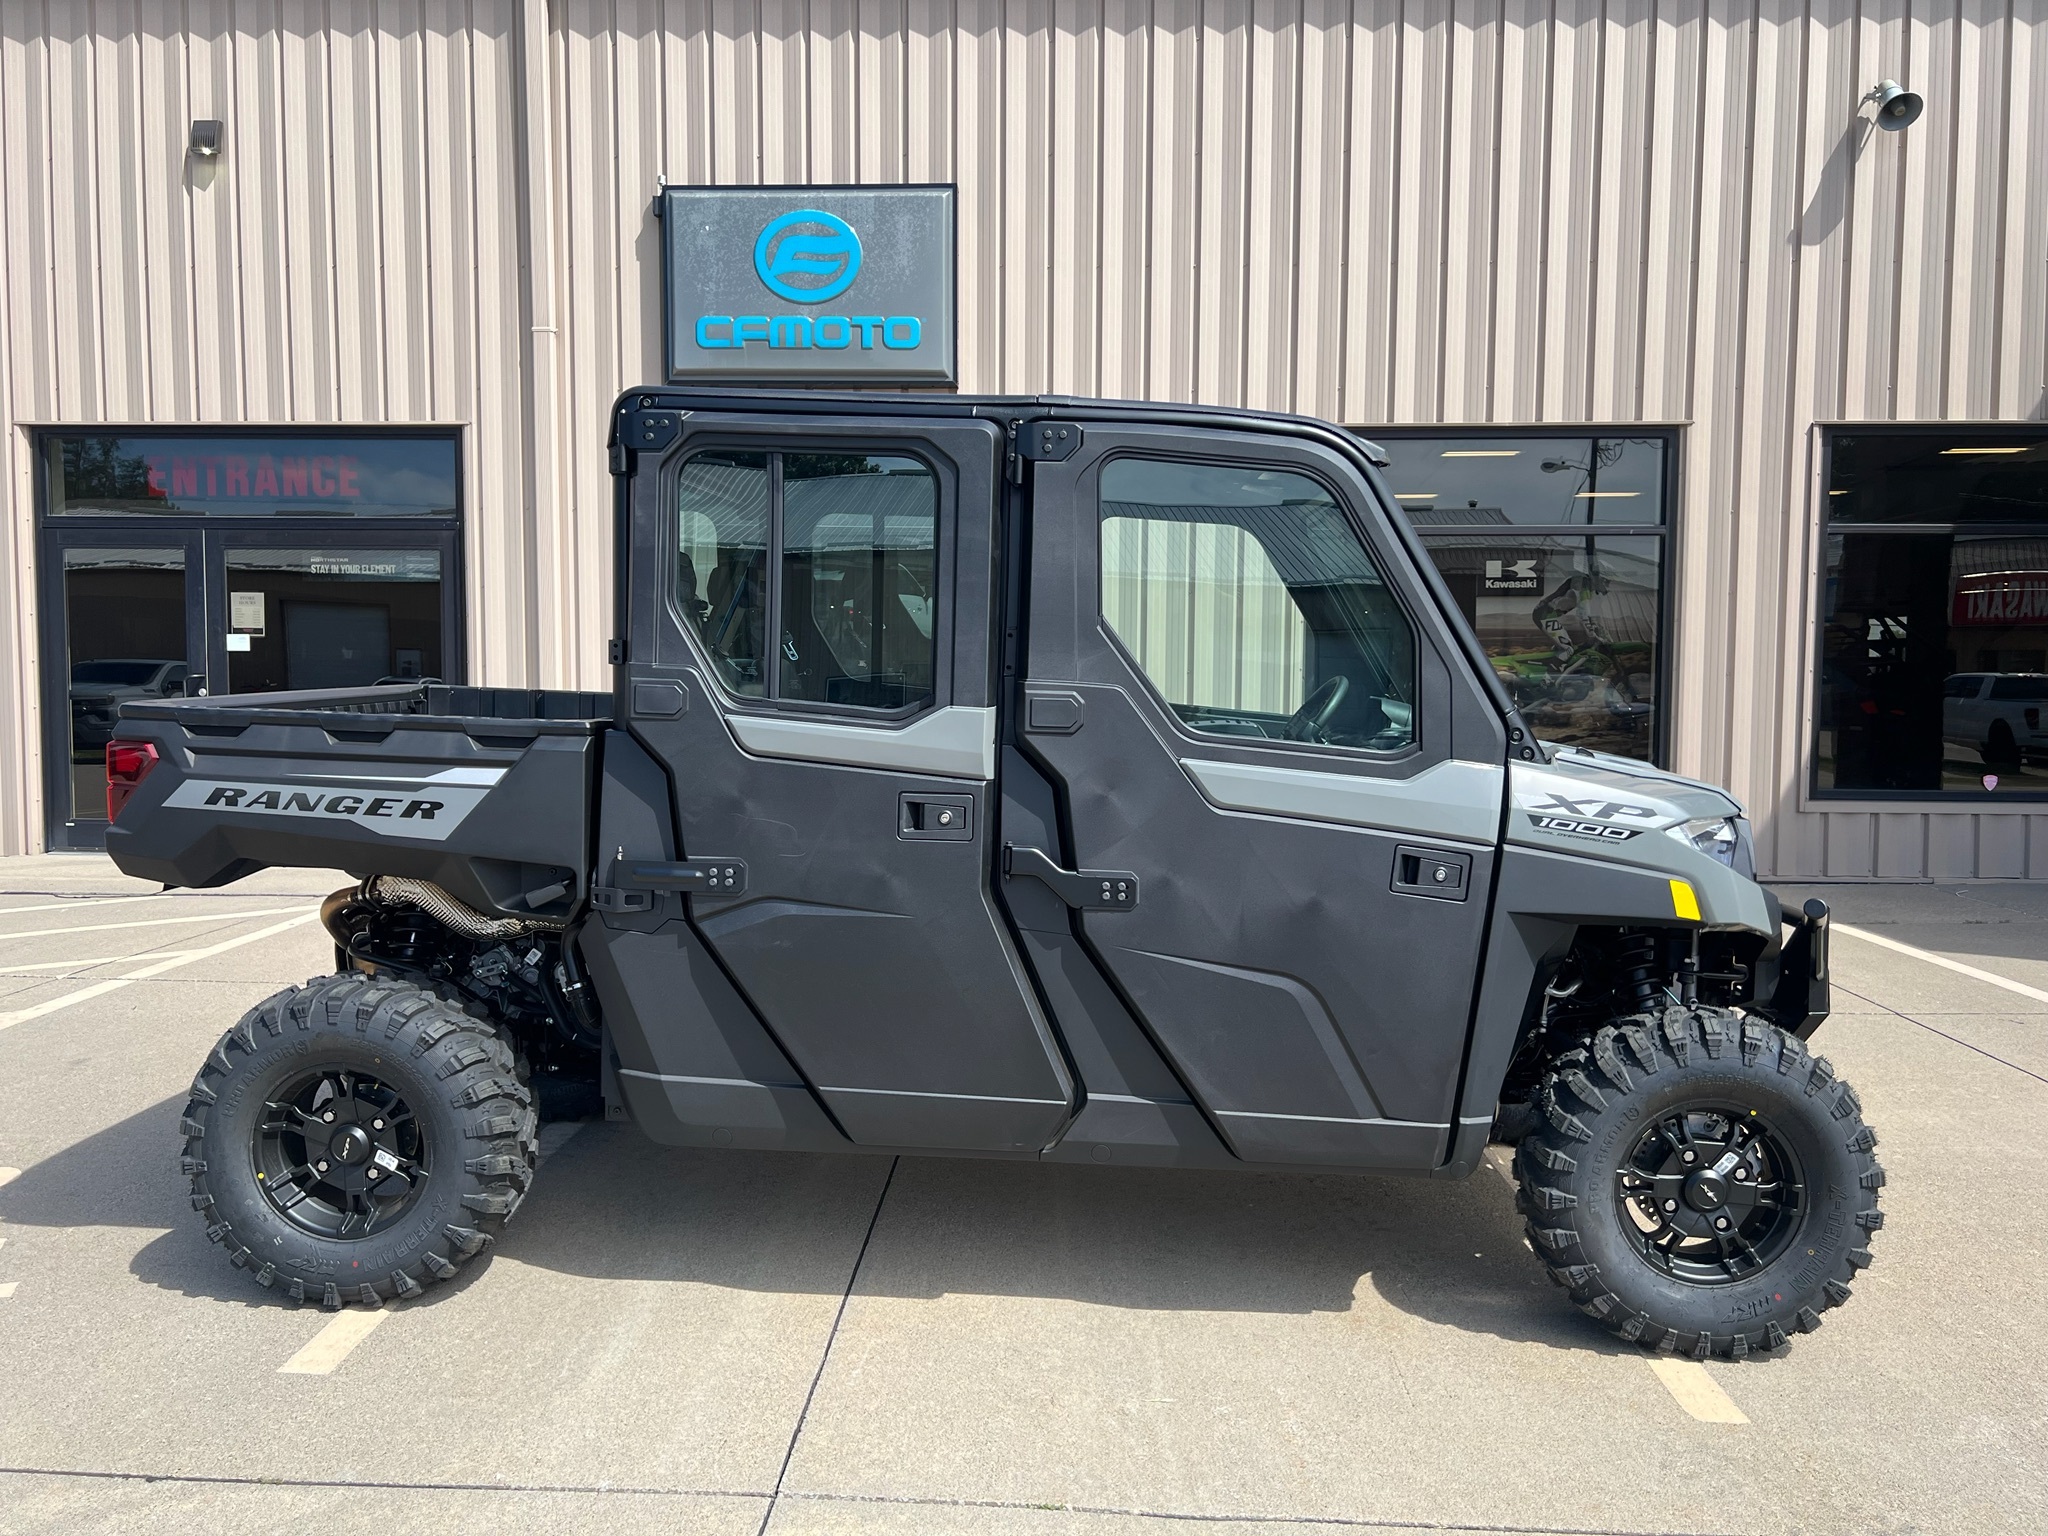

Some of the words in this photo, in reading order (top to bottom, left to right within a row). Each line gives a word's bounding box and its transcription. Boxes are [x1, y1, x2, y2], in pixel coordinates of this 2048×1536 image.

[695, 315, 922, 350] CFMOTO
[148, 455, 361, 498] ENTRANCE
[310, 564, 330, 574] STAY
[331, 564, 340, 574] IN
[341, 564, 361, 574] YOUR
[362, 564, 397, 575] ELEMENT
[1485, 579, 1537, 589] Kawasaki
[203, 787, 445, 820] RANGER
[1528, 792, 1658, 820] XP
[1532, 828, 1555, 837] DUAL
[1556, 831, 1601, 843] OVERHEAD
[1538, 817, 1631, 839] 1000
